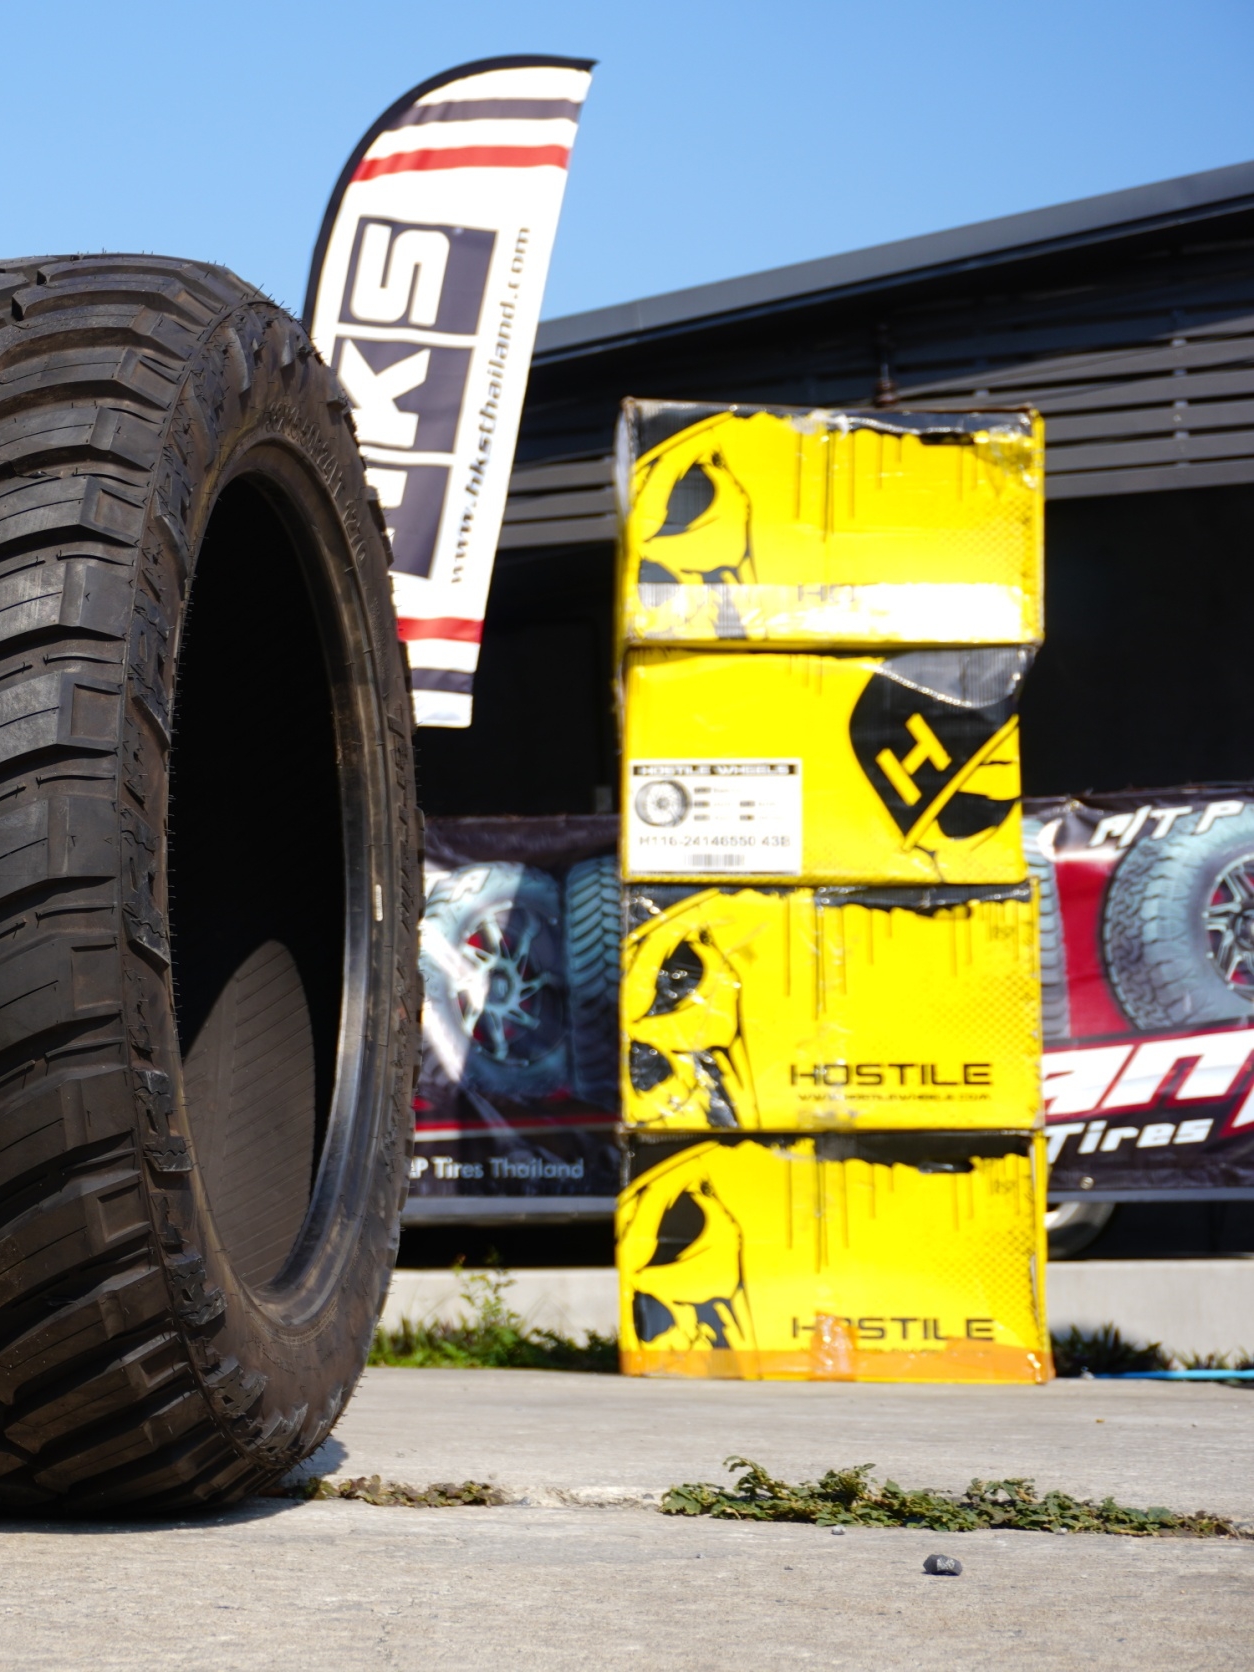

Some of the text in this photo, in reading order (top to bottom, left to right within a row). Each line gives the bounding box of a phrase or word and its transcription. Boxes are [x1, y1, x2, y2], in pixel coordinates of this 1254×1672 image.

[452, 225, 530, 583] www.hksthailand.com
[639, 765, 790, 775] HOSTILE WHEELS
[790, 1063, 991, 1086] HOSTILE
[1047, 1118, 1214, 1163] Tires
[431, 1155, 485, 1179] Tires
[488, 1157, 585, 1179] Thailand
